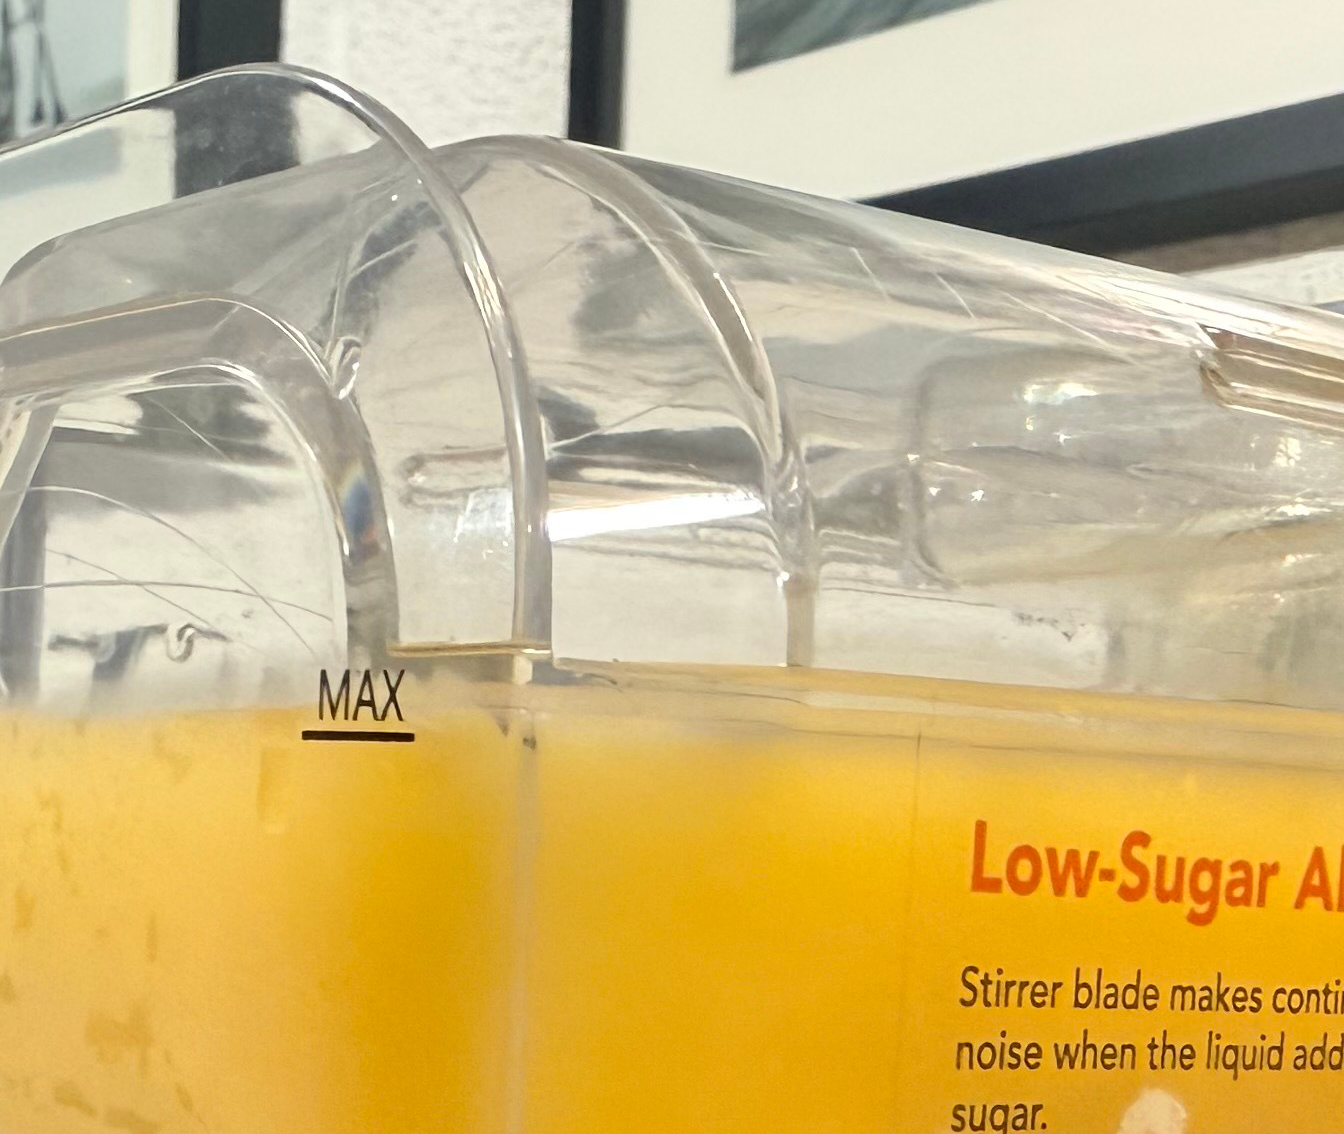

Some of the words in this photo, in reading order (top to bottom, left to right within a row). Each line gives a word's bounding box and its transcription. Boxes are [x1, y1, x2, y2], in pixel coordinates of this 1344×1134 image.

[319, 669, 405, 721] MAX
[969, 819, 1280, 926] Low-Sugar
[958, 966, 1062, 1010] Stirrer
[1073, 967, 1160, 1012] blade
[1170, 972, 1263, 1014] makes
[955, 1030, 1043, 1071] noise
[1054, 1030, 1136, 1070] when
[1148, 1030, 1196, 1071] the
[1206, 1031, 1284, 1080] liquid
